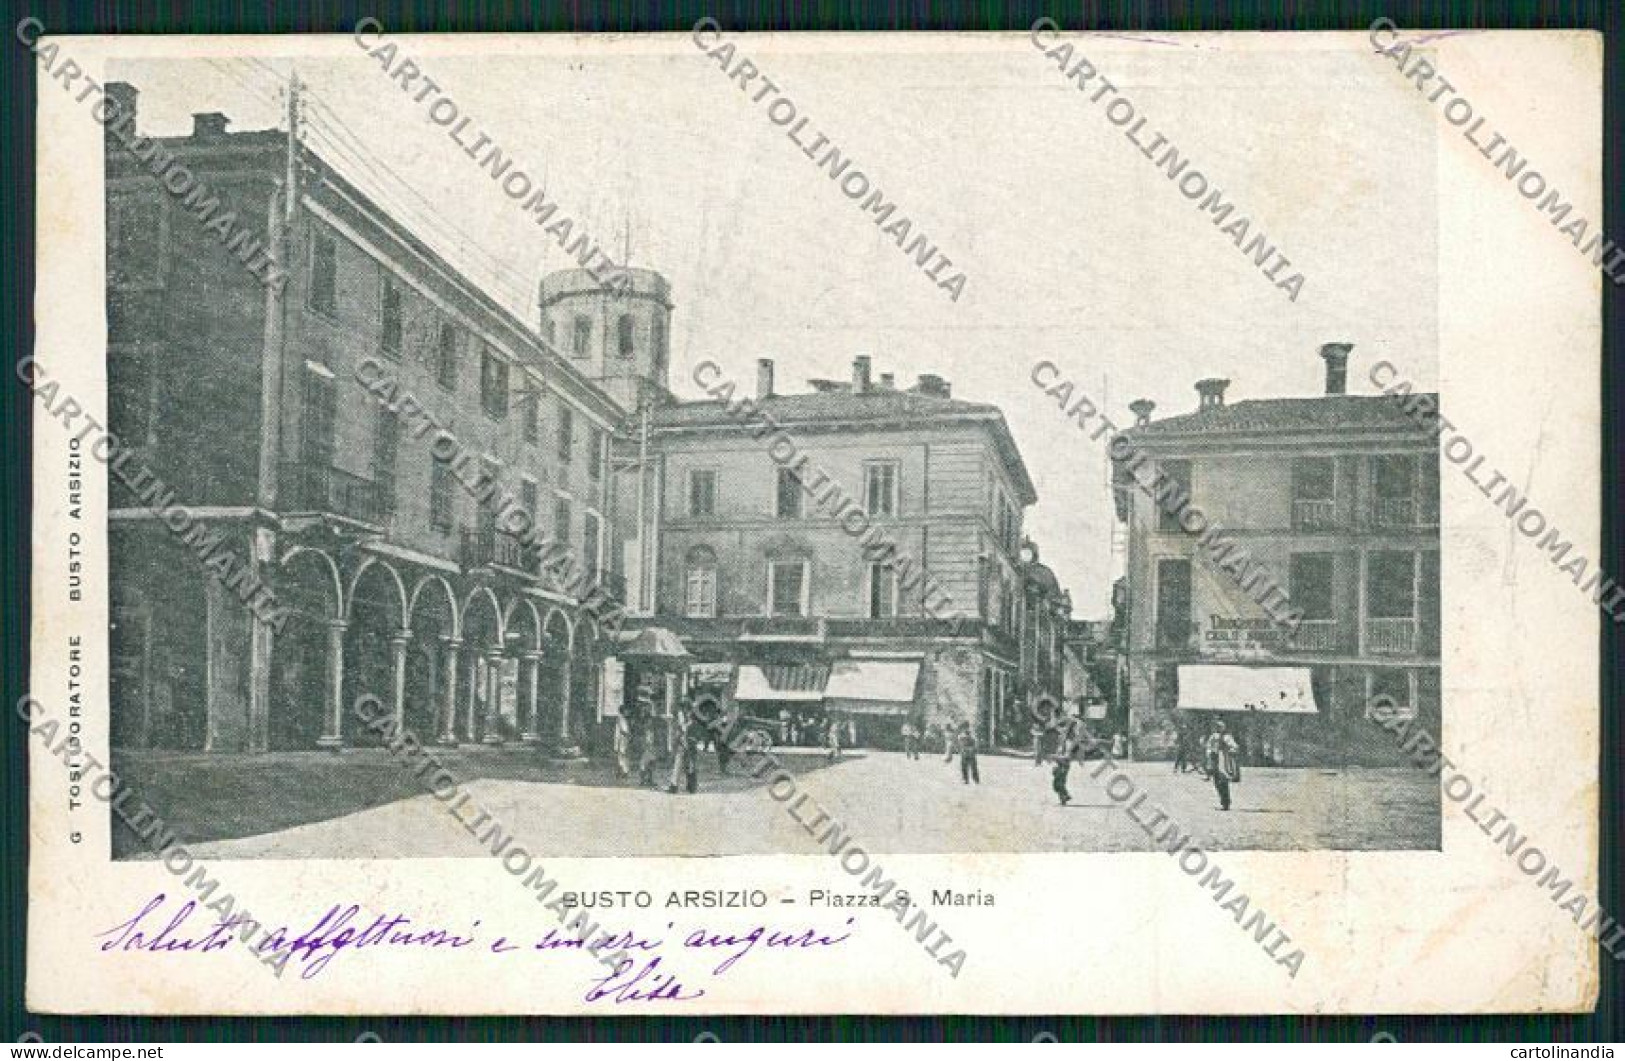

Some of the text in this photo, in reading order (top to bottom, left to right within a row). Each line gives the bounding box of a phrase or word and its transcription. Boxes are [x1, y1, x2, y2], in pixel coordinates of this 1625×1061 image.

[69, 437, 81, 519] ARSIZIO
[69, 532, 81, 601] BUSTO
[70, 635, 81, 747] DORATORE
[70, 764, 81, 810] TOSI
[95, 893, 254, 952] Saluti
[684, 917, 856, 975] auguri
[562, 890, 652, 908] BUSTO
[665, 890, 768, 908] ARSIZIO
[810, 889, 880, 907] Piazza
[895, 890, 917, 907] S.
[932, 889, 995, 906] Maria
